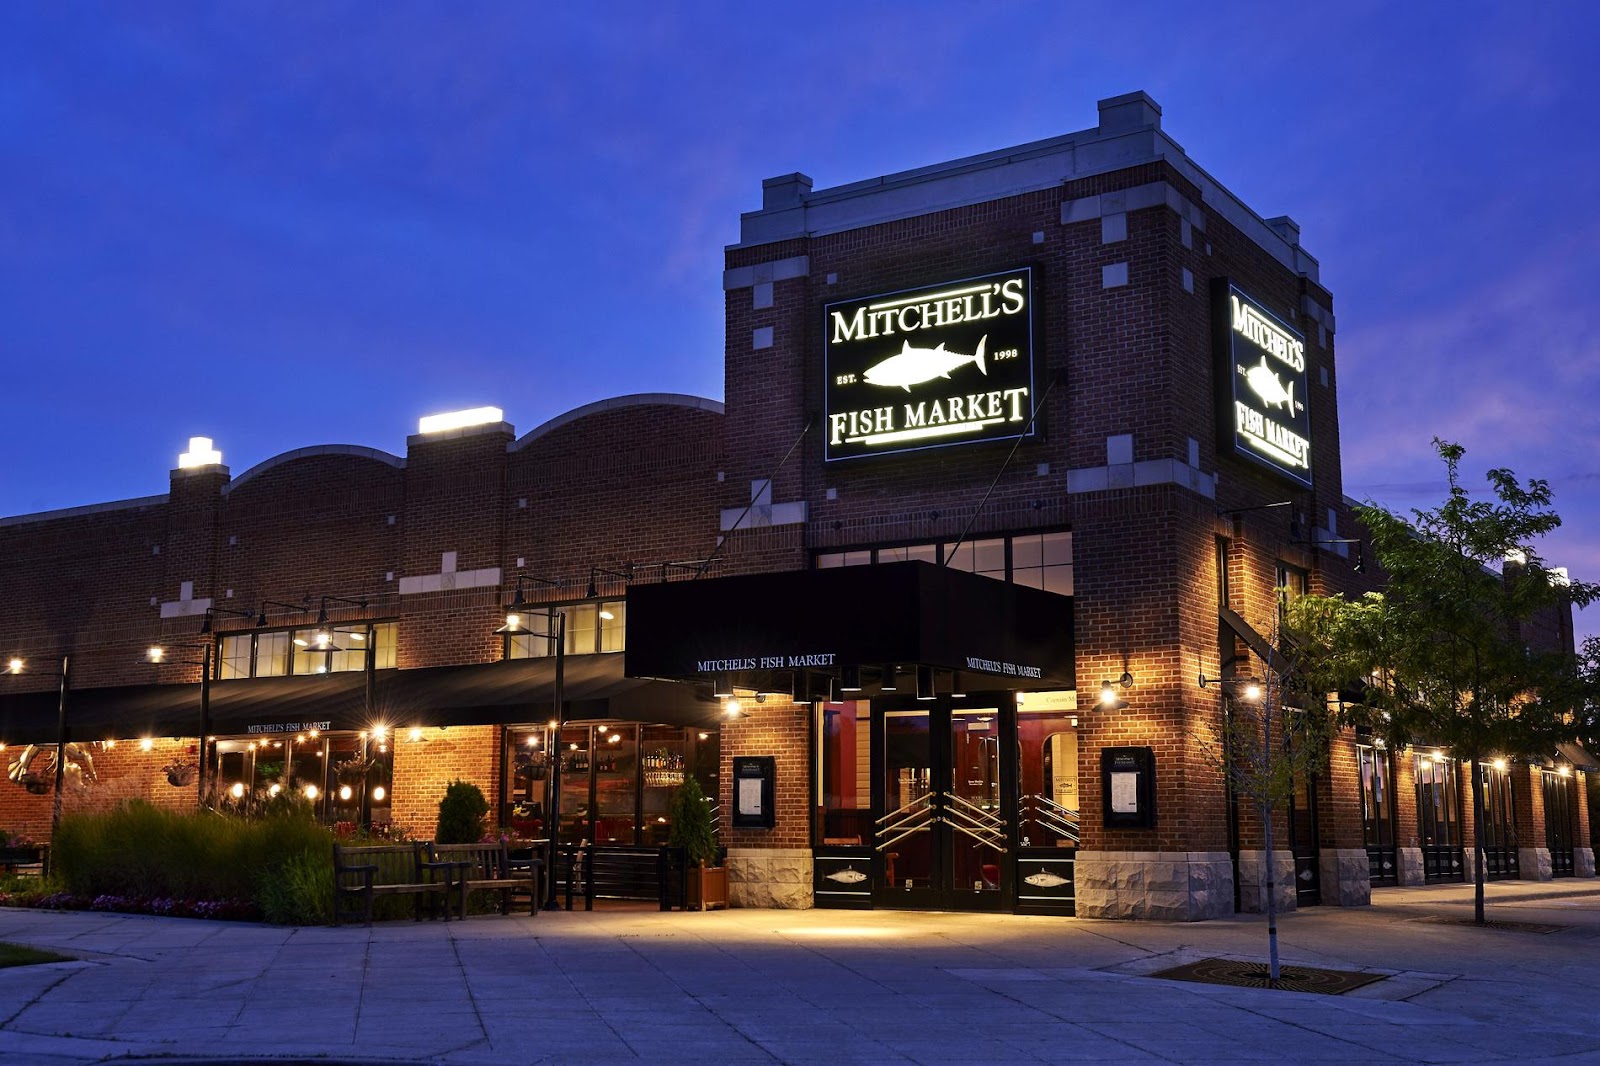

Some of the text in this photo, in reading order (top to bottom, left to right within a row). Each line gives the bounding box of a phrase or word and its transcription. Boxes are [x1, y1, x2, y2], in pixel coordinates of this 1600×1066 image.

[830, 279, 1024, 344] MITCHELL'S
[1231, 296, 1305, 373] MITCHELL'S
[994, 349, 1018, 360] 1998
[836, 374, 857, 385] EST.
[830, 388, 1027, 445] FISH MARKET
[1235, 400, 1309, 469] FISH MARKET
[697, 653, 836, 672] MITCHELL'S FISH MARKET
[966, 657, 1041, 678] MITCHELL'S FISH MARKET
[247, 721, 331, 734] MITCHELL'S FISH MARKET
